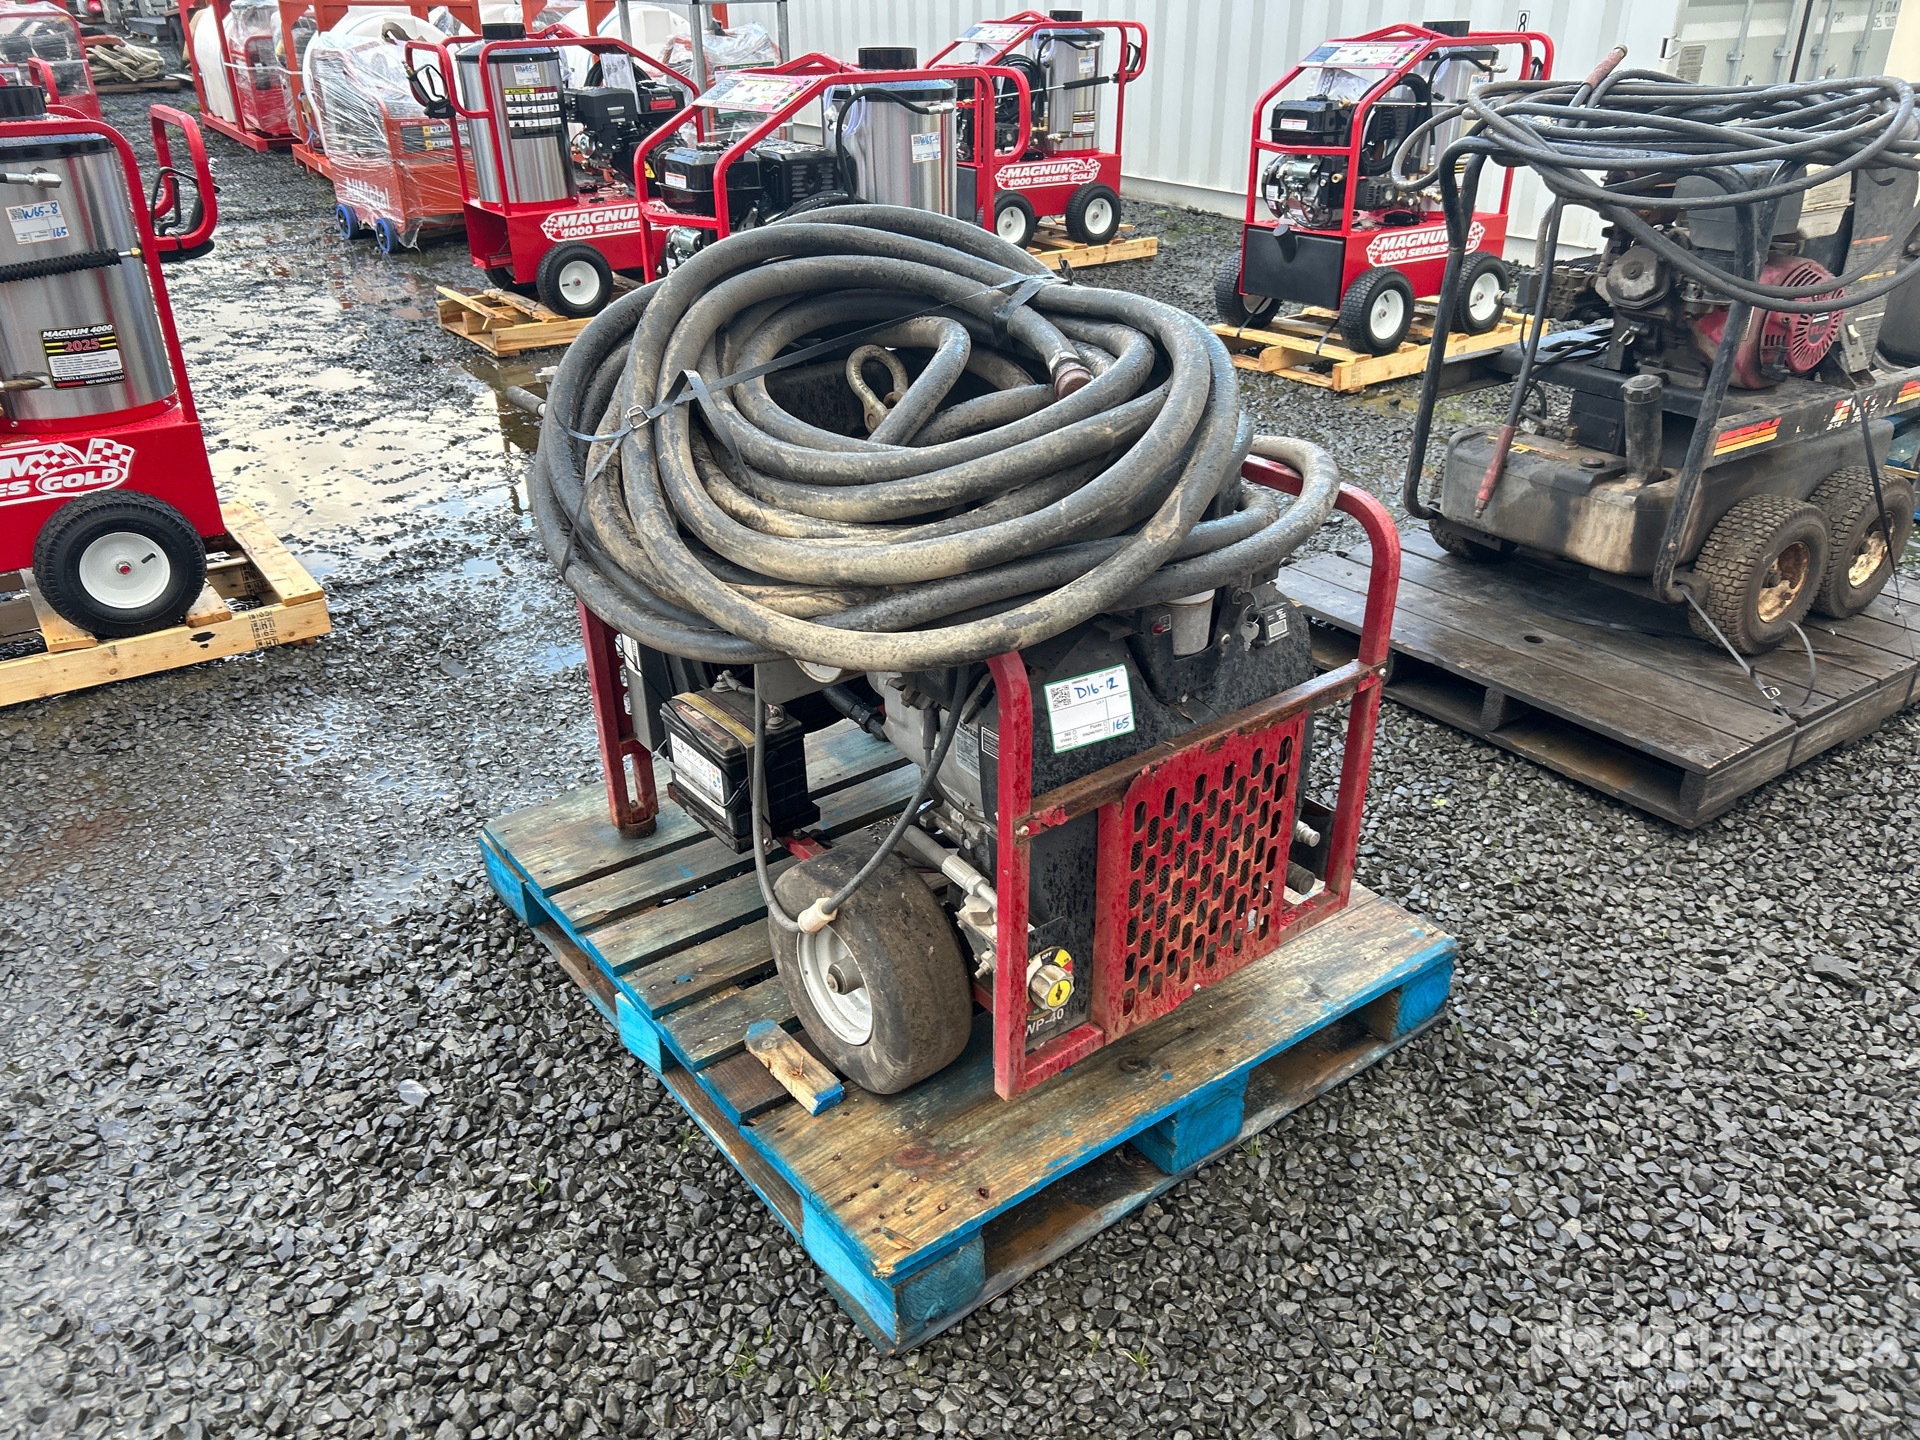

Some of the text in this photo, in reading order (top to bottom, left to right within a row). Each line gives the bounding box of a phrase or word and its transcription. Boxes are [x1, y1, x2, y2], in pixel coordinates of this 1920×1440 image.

[1518, 13, 1527, 32] 8
[1008, 164, 1073, 178] MAGNUM
[1008, 172, 1095, 187] 4000 SERIES GOLD
[22, 202, 58, 219] W65-8
[557, 207, 640, 228] MAGNU
[52, 226, 67, 237] 165
[560, 225, 594, 238] 4000
[1381, 249, 1406, 262] 4000
[1407, 243, 1450, 257] SERIES
[43, 327, 89, 338] MAGNUM
[90, 324, 113, 333] 4000
[63, 338, 100, 353] 2025
[41, 467, 119, 492] GOLD
[1112, 717, 1130, 733] 165
